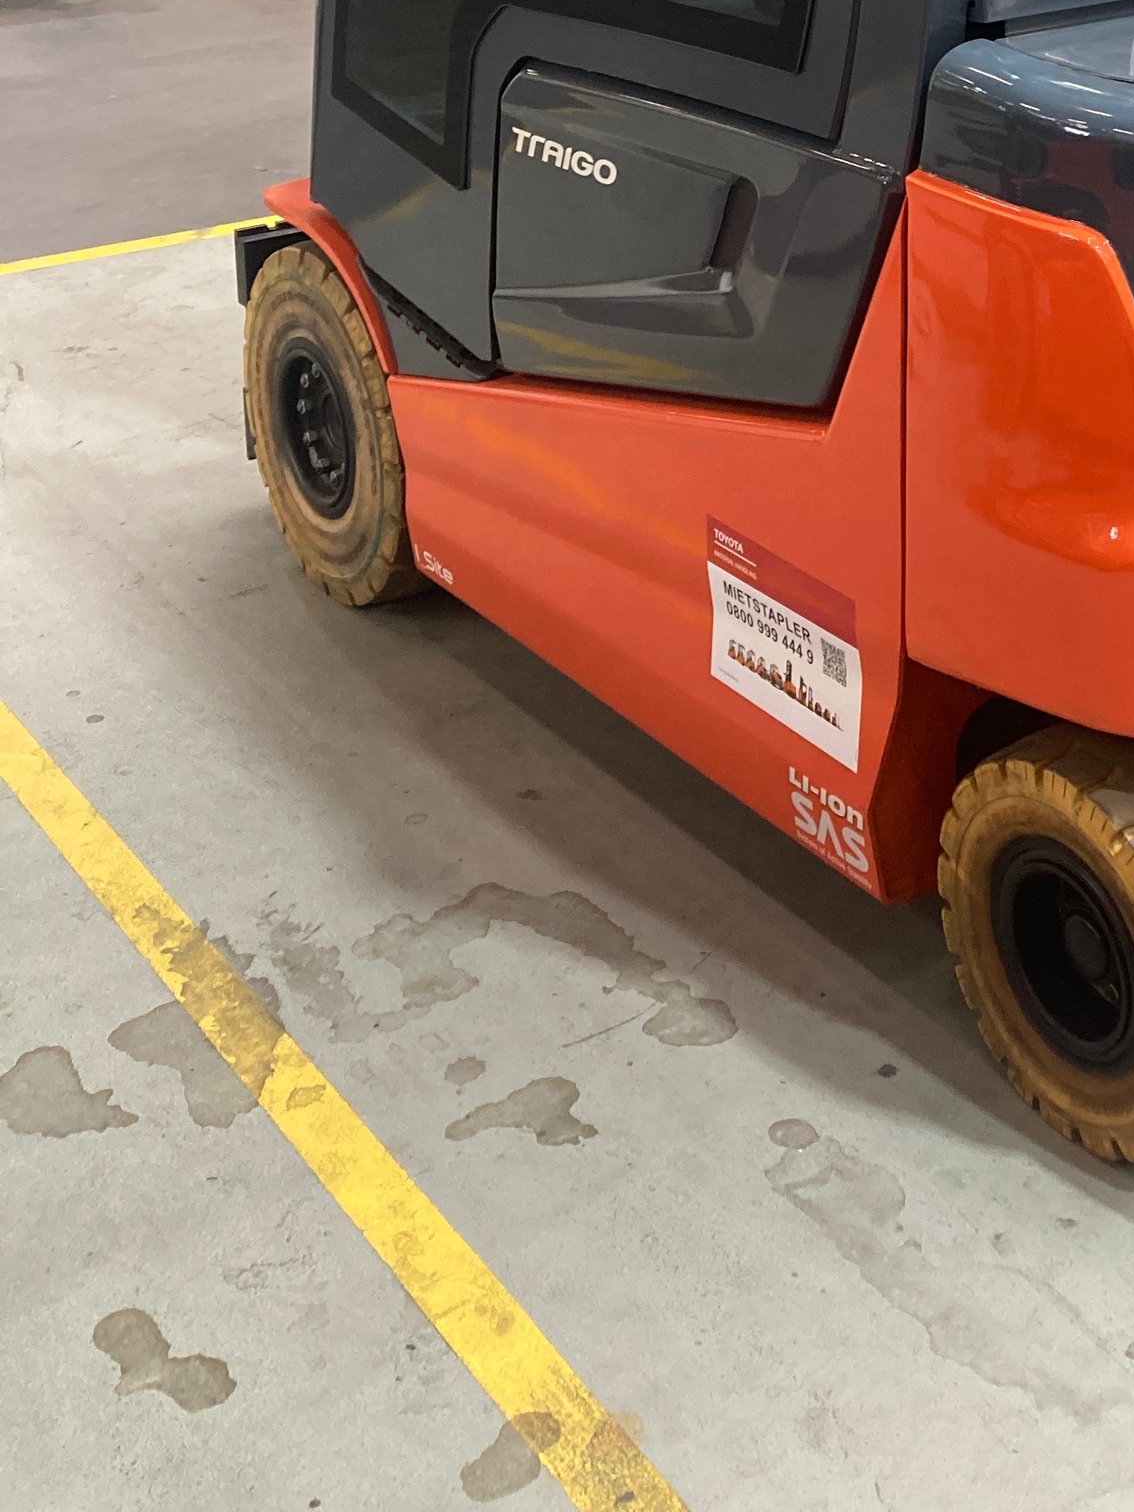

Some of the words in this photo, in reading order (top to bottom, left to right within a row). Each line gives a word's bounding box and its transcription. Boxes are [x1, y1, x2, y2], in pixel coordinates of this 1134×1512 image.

[713, 527, 744, 554] TOYOTA
[722, 580, 812, 645] MIETSTAPLER
[726, 600, 754, 628] 0800
[757, 619, 778, 643] 999
[781, 635, 803, 659] 444
[806, 649, 814, 665] 9
[791, 791, 869, 873] SAS
